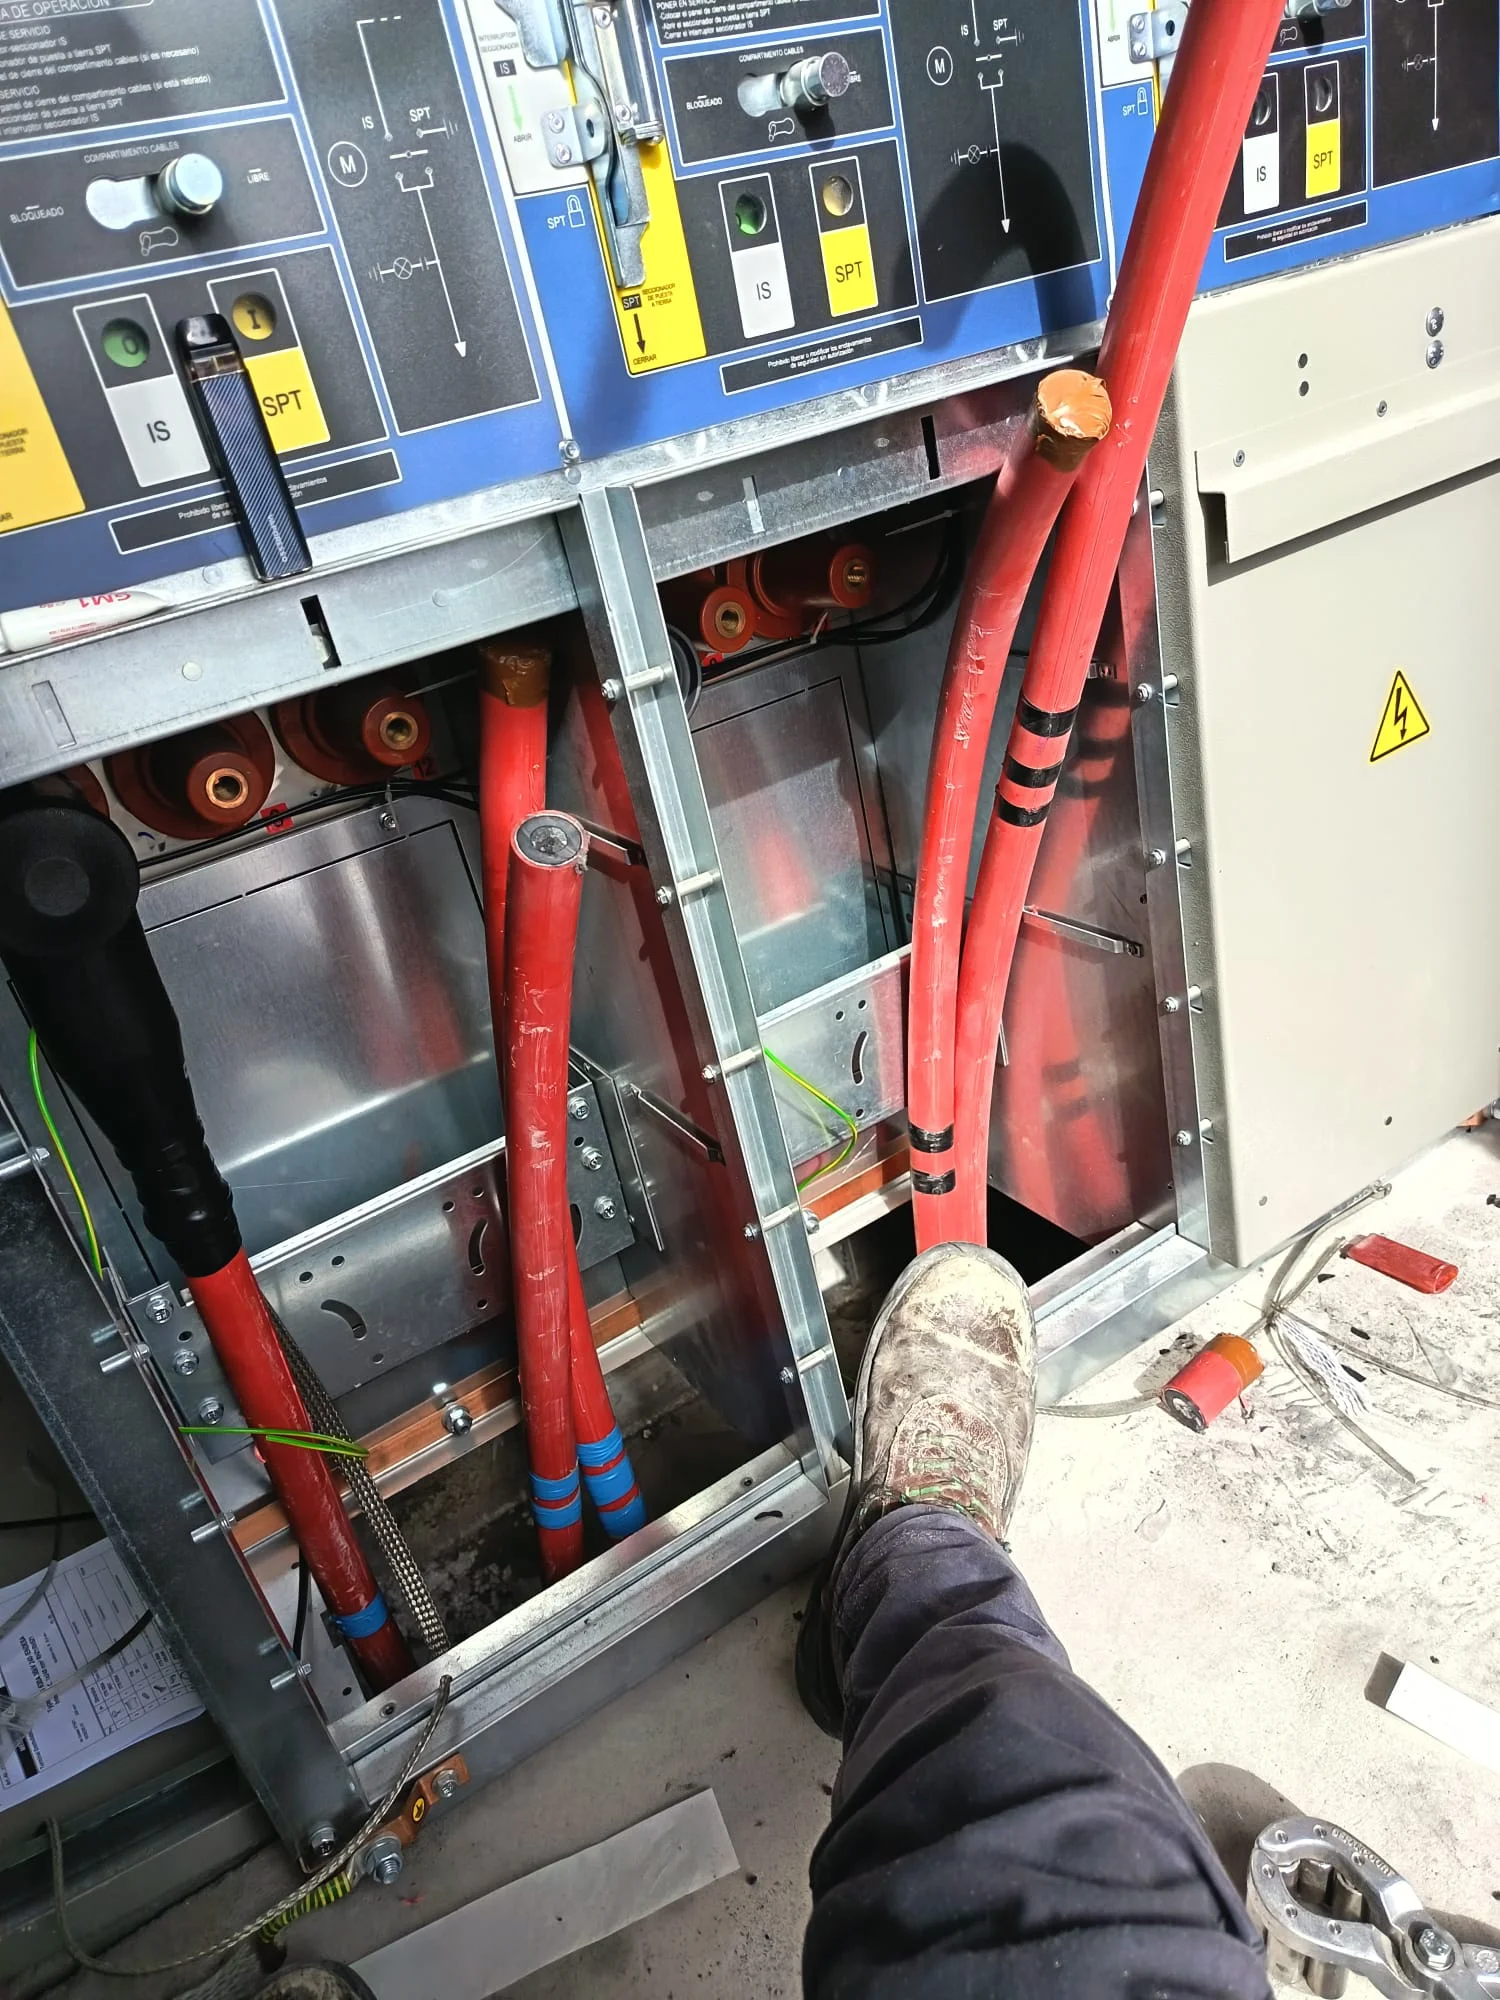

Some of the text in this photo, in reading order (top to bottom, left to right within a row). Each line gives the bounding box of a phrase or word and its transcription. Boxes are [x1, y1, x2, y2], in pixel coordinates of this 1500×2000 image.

[11, 4, 30, 19] DE
[656, 1, 677, 10] PONER
[961, 24, 969, 36] IS
[993, 18, 1008, 31] SPT
[9, 25, 51, 40] SERVICIO
[94, 43, 112, 55] SPT
[738, 45, 804, 63] COMPARTIMENTO CABLES
[500, 62, 510, 75] IS
[934, 58, 946, 74] M
[106, 97, 123, 109] SPT
[686, 97, 723, 111] BLOQUEADO
[1122, 103, 1136, 117] SPT
[362, 116, 374, 129] IS
[409, 107, 431, 123] SPT
[84, 140, 180, 164] COMPARTIMENTO CABLES
[339, 155, 357, 174] M
[1313, 150, 1333, 170] SPT
[247, 171, 270, 184] LIBRE
[1256, 165, 1267, 183] IS
[10, 206, 64, 223] BLOQUEADO
[547, 215, 567, 230] SPT
[835, 261, 863, 283] SPT
[756, 281, 772, 301] IS
[623, 296, 640, 309] SPT
[632, 354, 658, 366] CERRAR
[767, 357, 790, 369] Prohibido
[790, 353, 805, 362] liberar
[809, 347, 830, 358] modificar
[838, 336, 873, 350] enclavamientos
[797, 357, 820, 367] seguridad
[262, 389, 302, 417] SPT
[146, 420, 171, 444] IS
[178, 506, 210, 520] Prohibido
[211, 511, 221, 520] de
[267, 514, 289, 563] VAPORESSO
